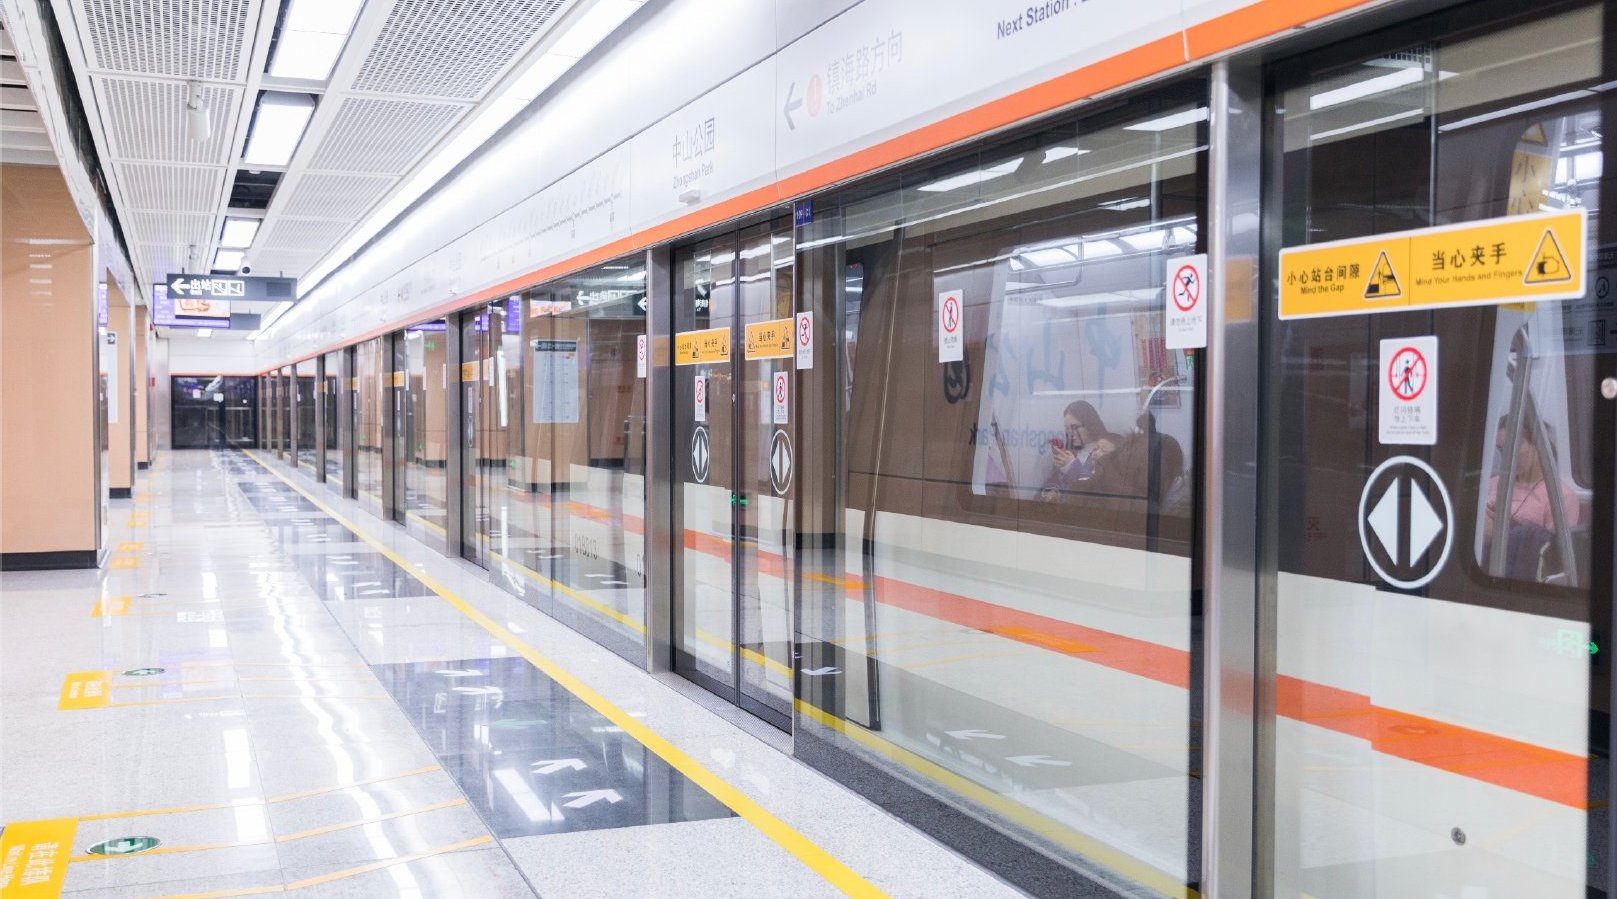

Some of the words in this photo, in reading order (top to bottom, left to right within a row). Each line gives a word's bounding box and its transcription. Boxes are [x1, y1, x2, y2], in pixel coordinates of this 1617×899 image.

[997, 13, 1023, 40] Next
[1026, 0, 1069, 27] Station
[866, 79, 877, 97] Rd
[672, 116, 715, 169] 中山公园
[1432, 242, 1507, 271] 当心夹手
[1287, 263, 1360, 286] 小心站台间隙
[1415, 276, 1432, 286] Mind
[1434, 274, 1450, 285] Your
[1452, 273, 1476, 283] Hands
[1477, 271, 1492, 281] and
[1493, 268, 1523, 280] Fingers
[1300, 285, 1316, 295] Mind
[1317, 284, 1329, 294] the
[1330, 283, 1345, 294] Gap
